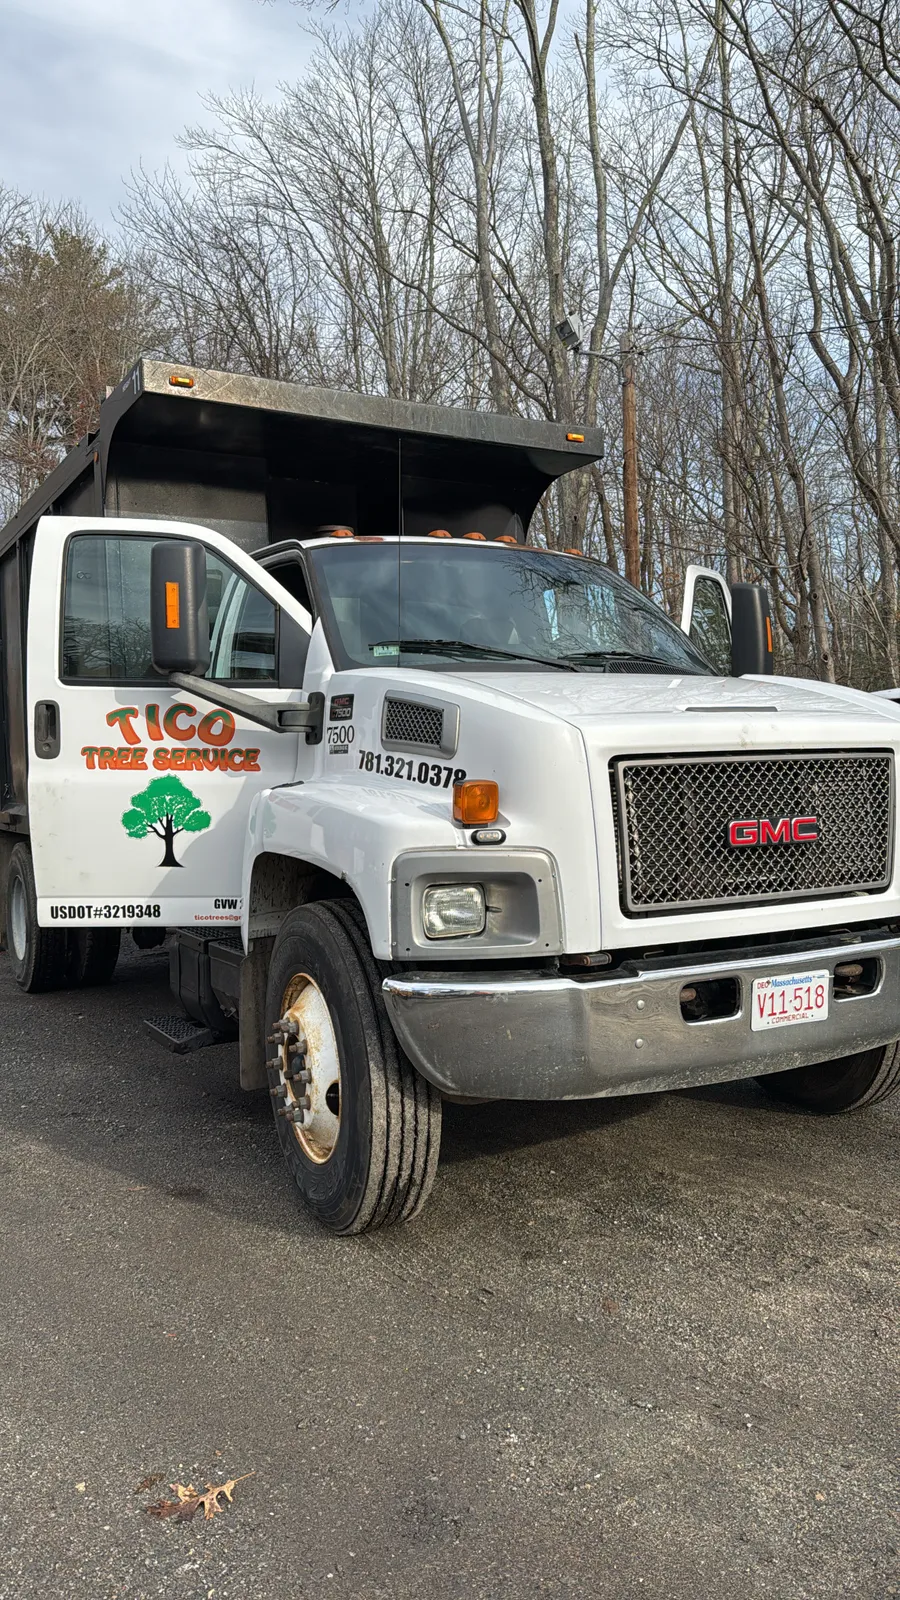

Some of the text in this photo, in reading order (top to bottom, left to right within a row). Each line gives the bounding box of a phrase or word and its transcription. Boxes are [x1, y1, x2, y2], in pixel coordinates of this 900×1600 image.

[334, 697, 350, 705] GMC
[106, 703, 236, 747] TICO
[327, 725, 355, 744] 7500
[81, 746, 261, 772] TREE SERVICE
[729, 817, 818, 846] GMC
[50, 904, 161, 919] USDOT#3219348
[214, 898, 238, 910] GVW
[771, 976, 813, 988] Massachusetts
[771, 1012, 809, 1024] COMMERCIAL
